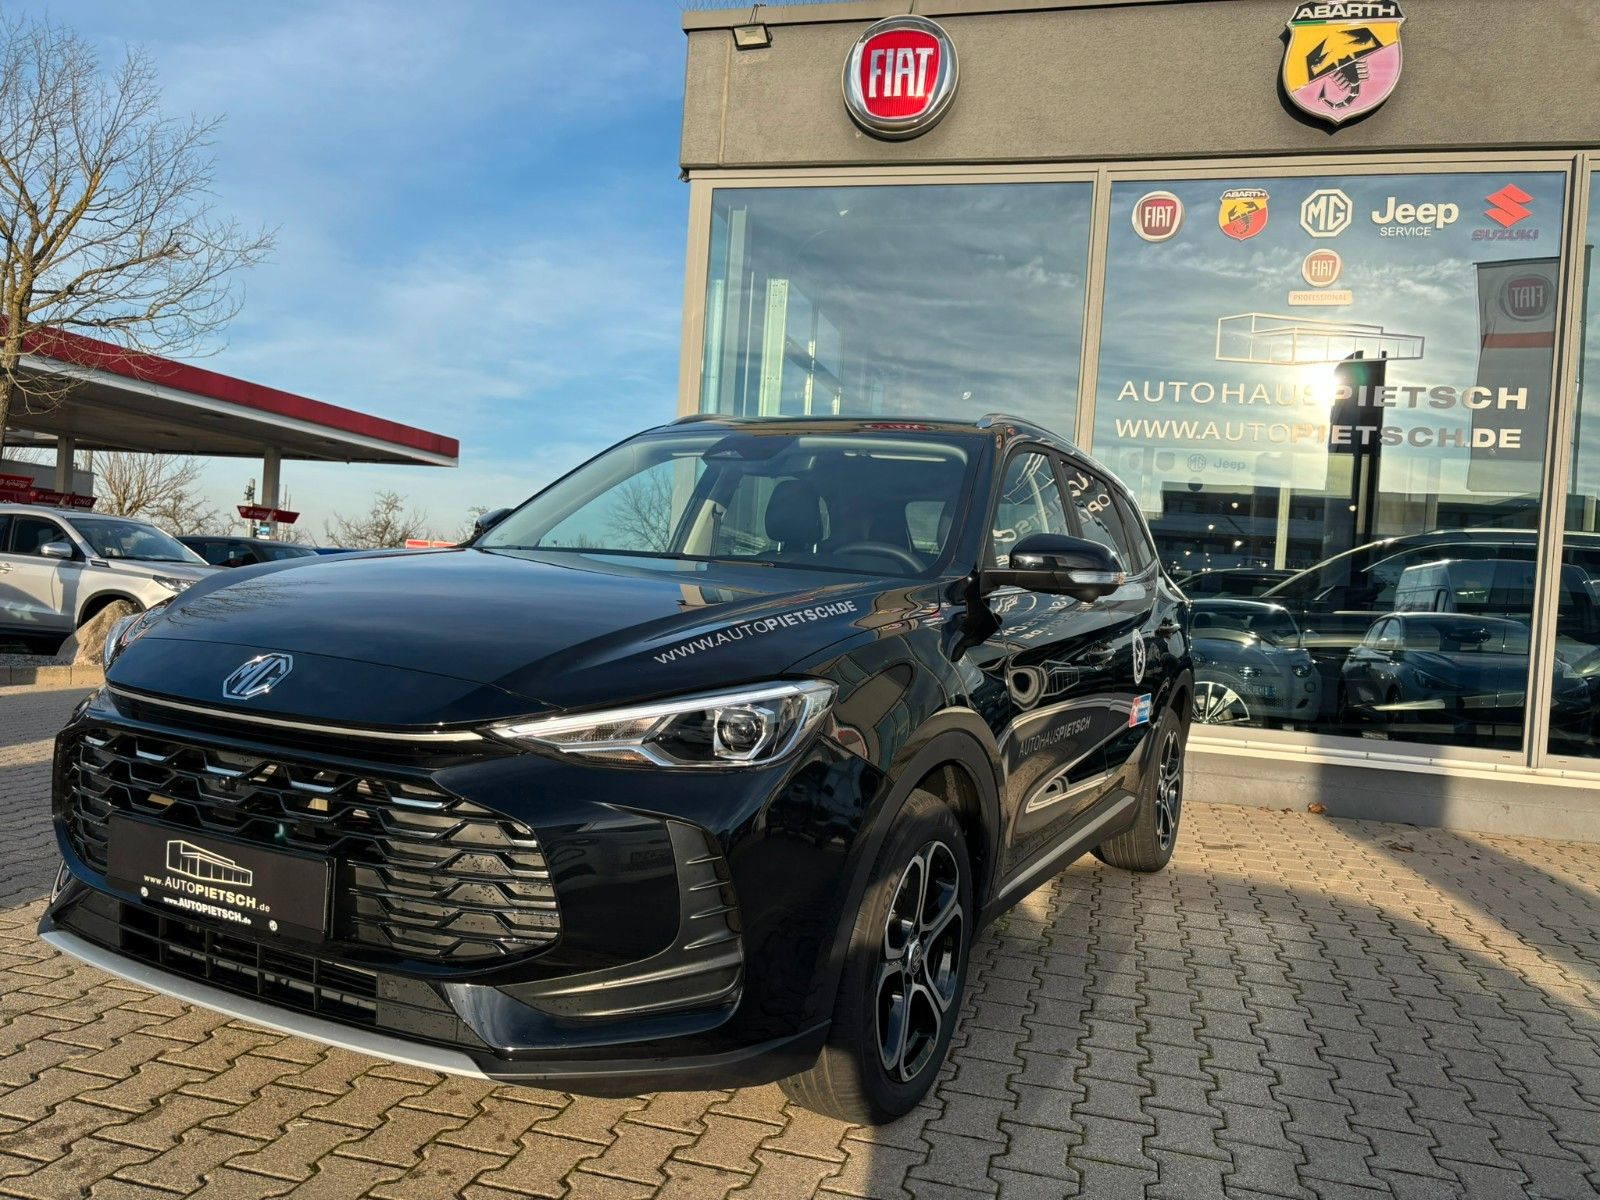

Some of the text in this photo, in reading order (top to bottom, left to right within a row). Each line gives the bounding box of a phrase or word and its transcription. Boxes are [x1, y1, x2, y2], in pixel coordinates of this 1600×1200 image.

[1296, 3, 1396, 19] ABARTH
[868, 47, 935, 98] FIAT
[1144, 204, 1174, 228] FIAT
[1371, 196, 1459, 229] Jeep
[1379, 226, 1432, 237] SERVICE
[1471, 228, 1539, 241] SUZUKI
[1311, 259, 1335, 277] FIAT
[1293, 293, 1348, 302] PROFESSIONAL
[1115, 418, 1522, 449] WWW.AUTOPIETSCH.DE
[653, 600, 858, 665] WWW.AUTOPIETSCH.DE
[1018, 715, 1093, 759] AUTOHAUSPIETSCH
